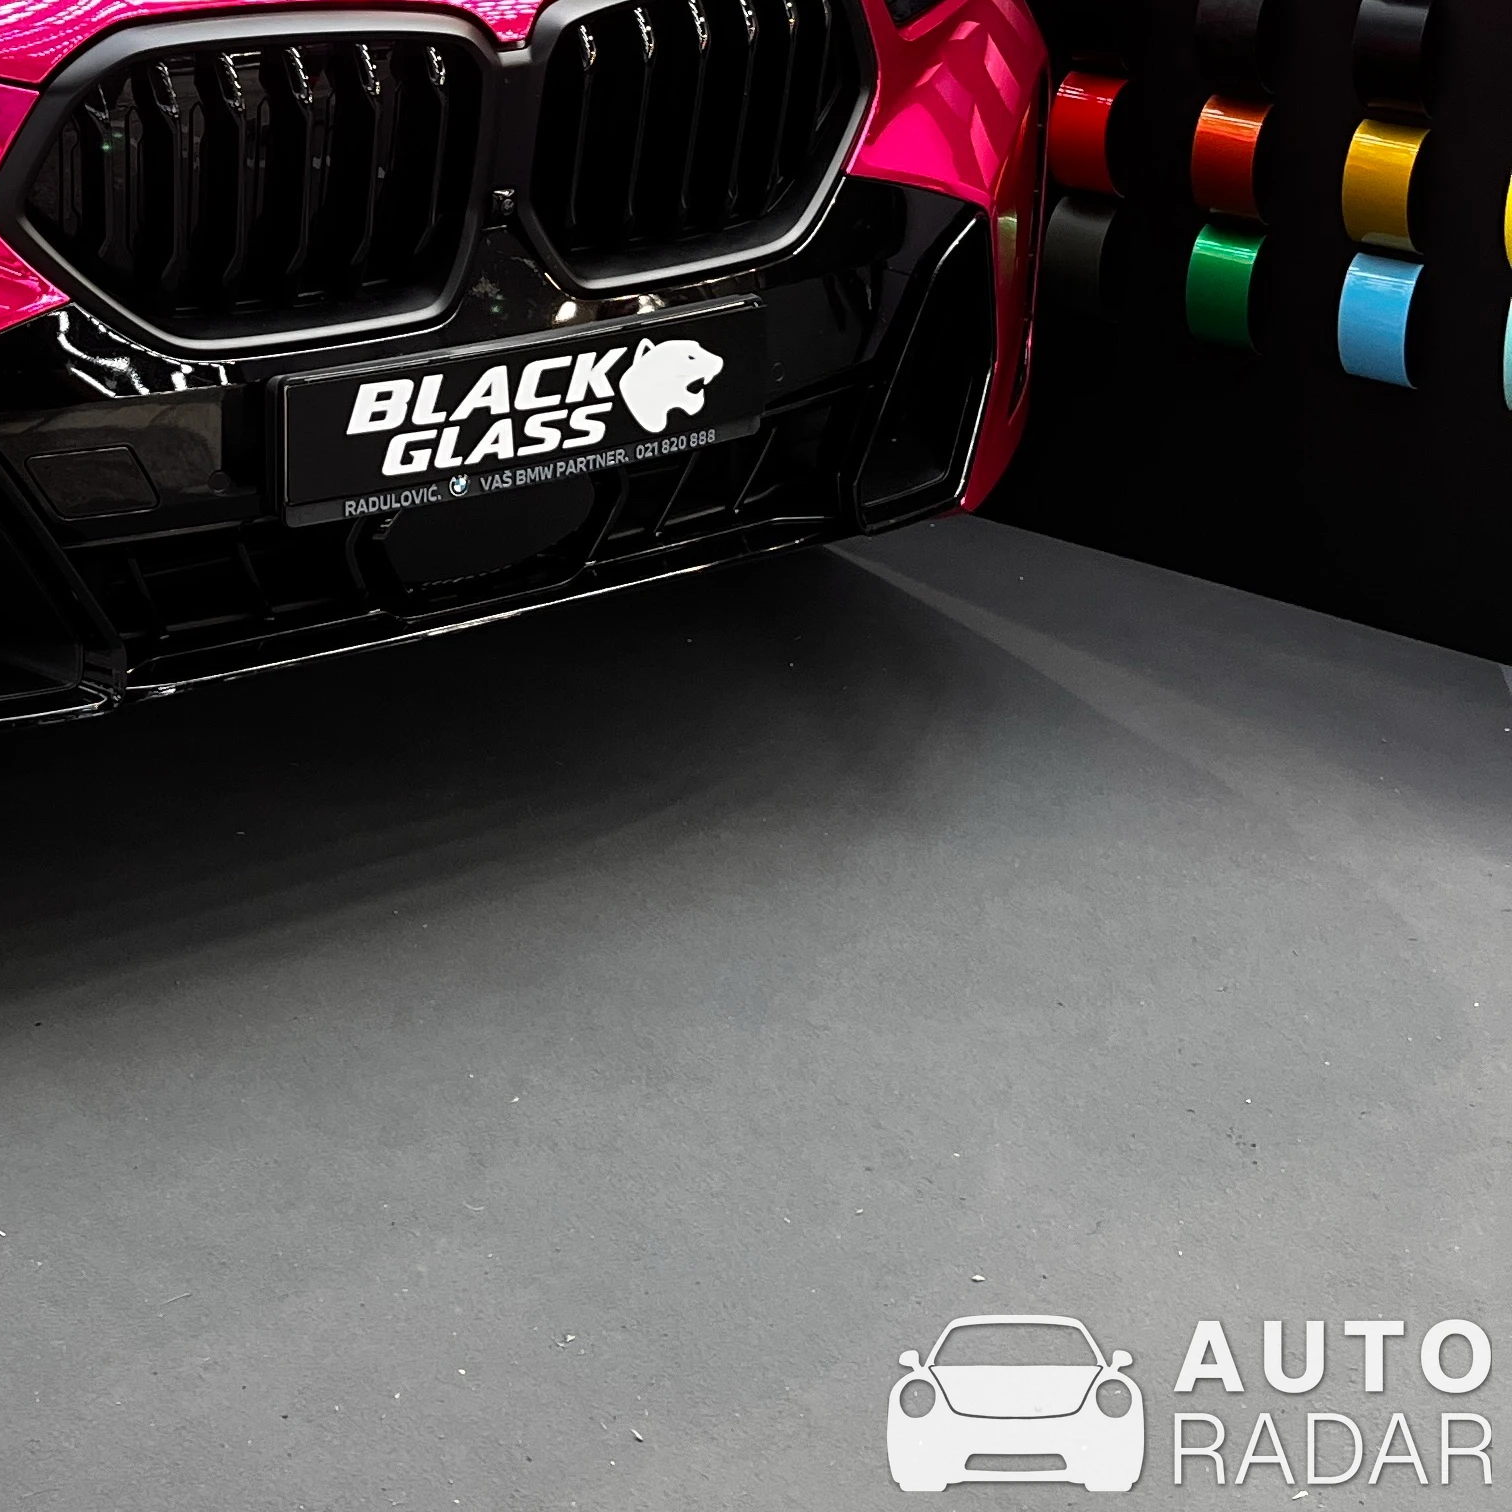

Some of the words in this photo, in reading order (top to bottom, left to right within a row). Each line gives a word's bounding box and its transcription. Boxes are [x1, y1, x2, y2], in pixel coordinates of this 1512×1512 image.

[346, 346, 628, 435] BLACK
[381, 402, 613, 476] GLASS
[480, 469, 512, 491] VAŠ
[515, 464, 554, 486] BMW
[636, 441, 659, 460] 021
[661, 435, 687, 454] 820
[690, 428, 716, 447] 888
